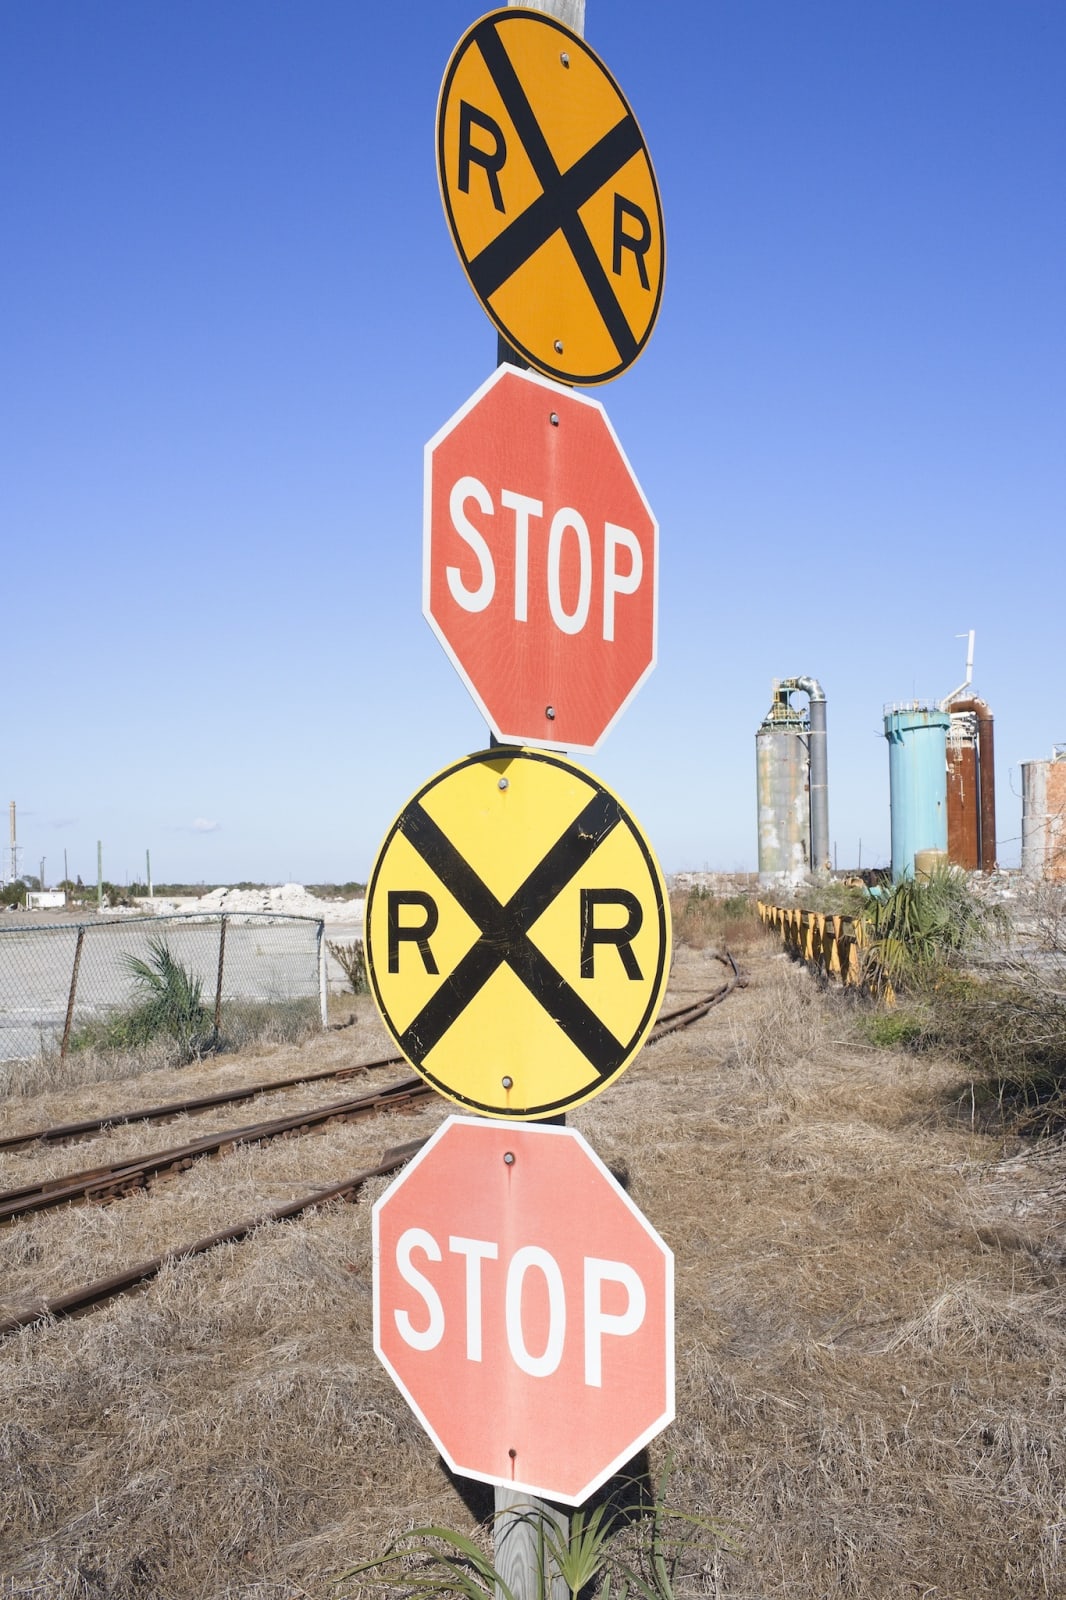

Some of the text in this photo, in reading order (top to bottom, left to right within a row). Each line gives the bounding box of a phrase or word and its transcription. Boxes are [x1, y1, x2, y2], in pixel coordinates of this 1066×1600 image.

[458, 99, 652, 292] R R
[446, 475, 643, 642] STOP
[387, 888, 644, 981] R R
[394, 1227, 647, 1388] STOP
